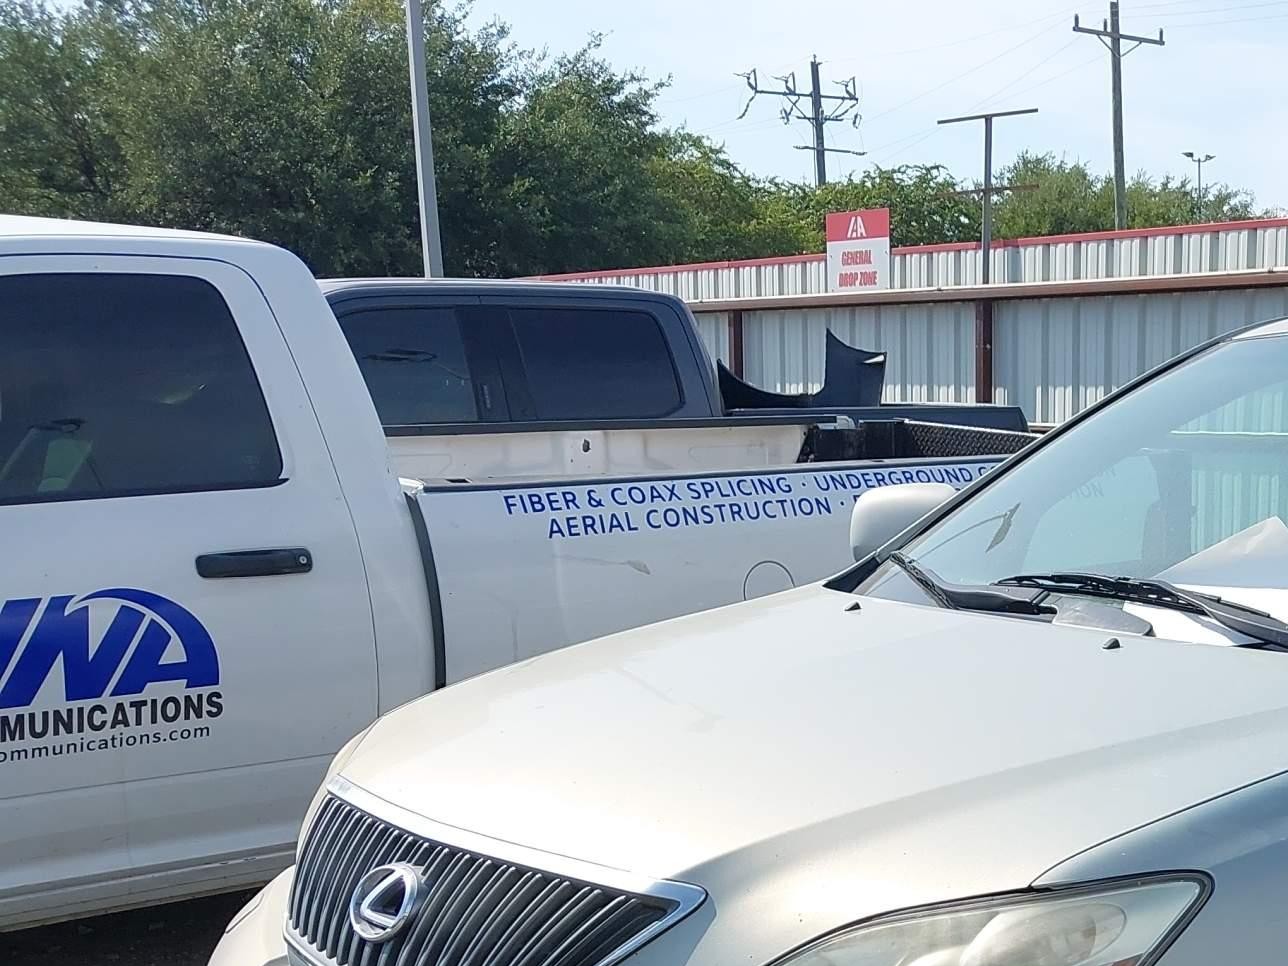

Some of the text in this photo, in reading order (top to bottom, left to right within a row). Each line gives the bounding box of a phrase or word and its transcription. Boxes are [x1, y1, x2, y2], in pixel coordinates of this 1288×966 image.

[842, 250, 872, 266] GENERAL
[839, 271, 877, 287] DROP ZONE
[503, 491, 581, 515] FIBER
[587, 490, 605, 508] &
[610, 484, 683, 506] COAX
[686, 476, 793, 500] SPLICING
[813, 467, 973, 492] UNDERGROUND
[548, 498, 832, 539] AERIAL CONSTRUCTION
